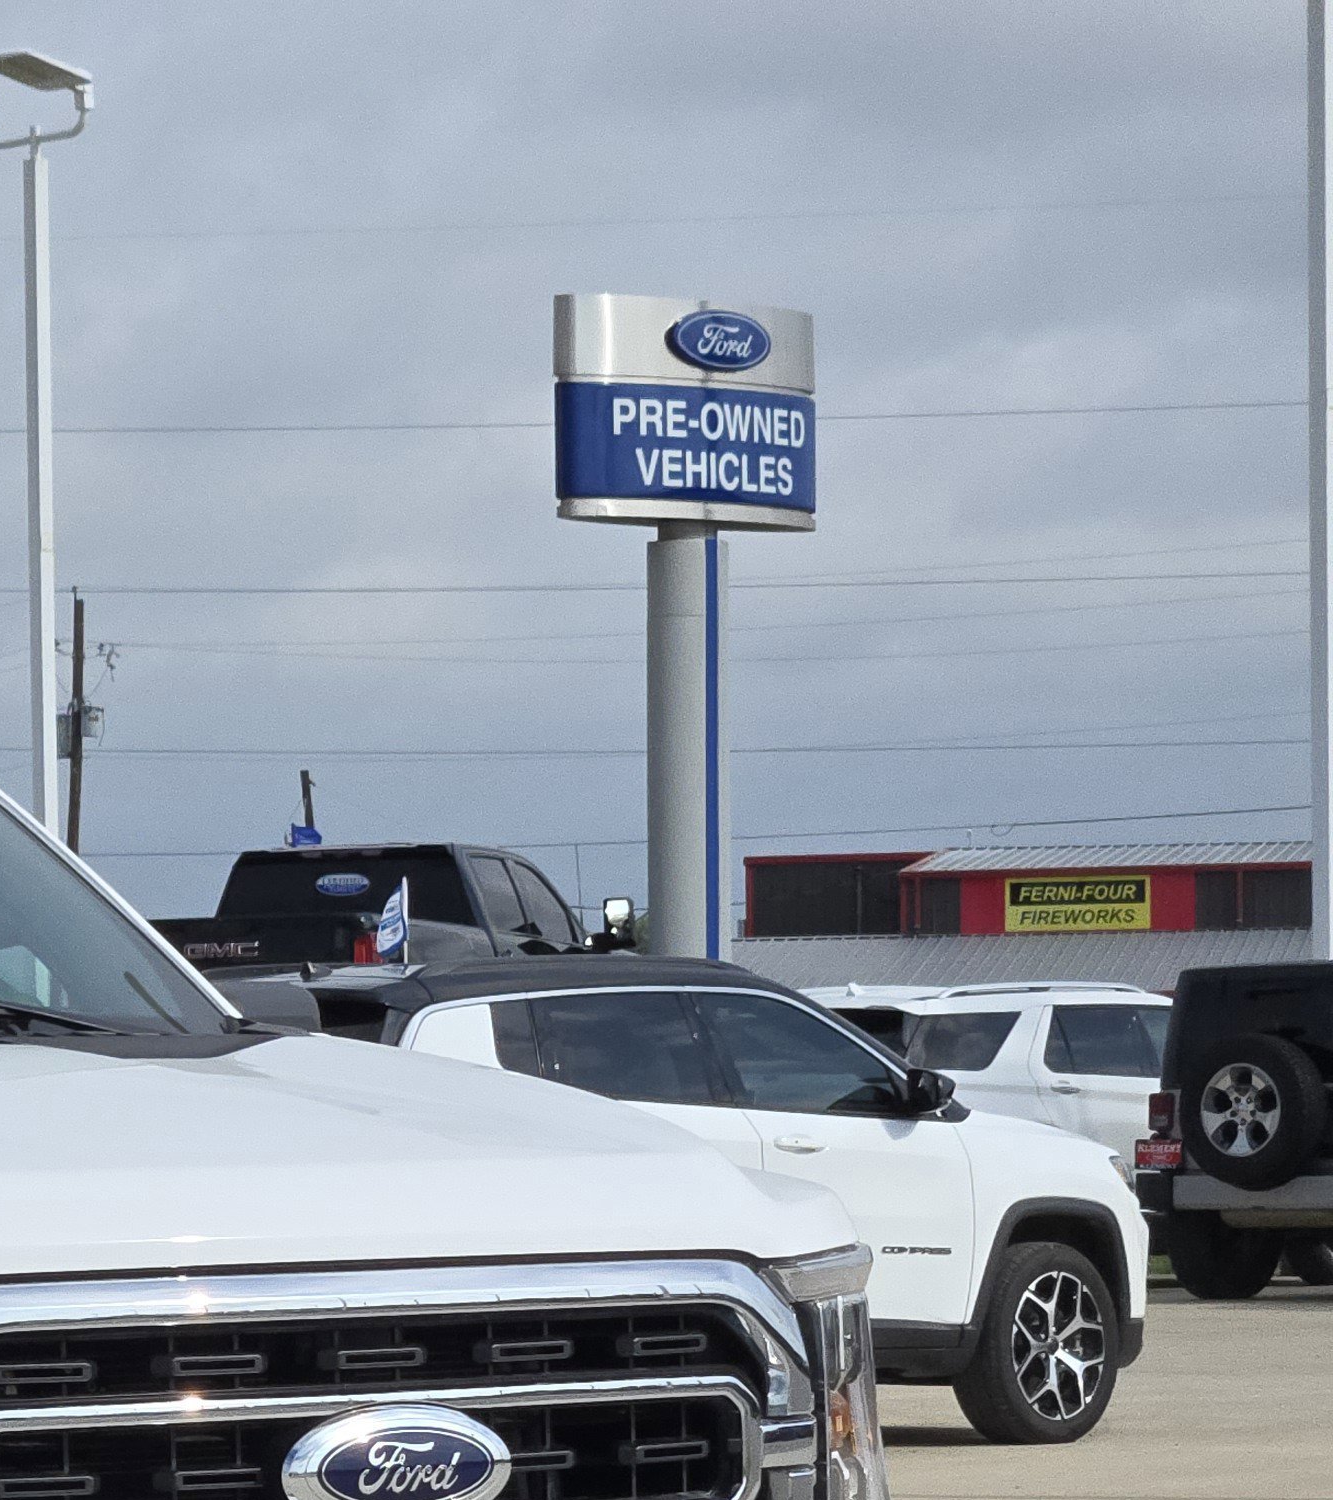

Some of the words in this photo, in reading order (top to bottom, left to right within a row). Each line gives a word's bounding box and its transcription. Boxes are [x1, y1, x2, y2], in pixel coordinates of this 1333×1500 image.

[696, 323, 753, 357] Ford
[612, 397, 806, 448] PRE-OWNED
[635, 447, 793, 496] VEHICLES
[1019, 884, 1137, 902] FERNI-FOUR
[1019, 909, 1136, 925] FIREWORKS
[184, 941, 259, 959] GMC
[357, 1441, 461, 1495] Ford
